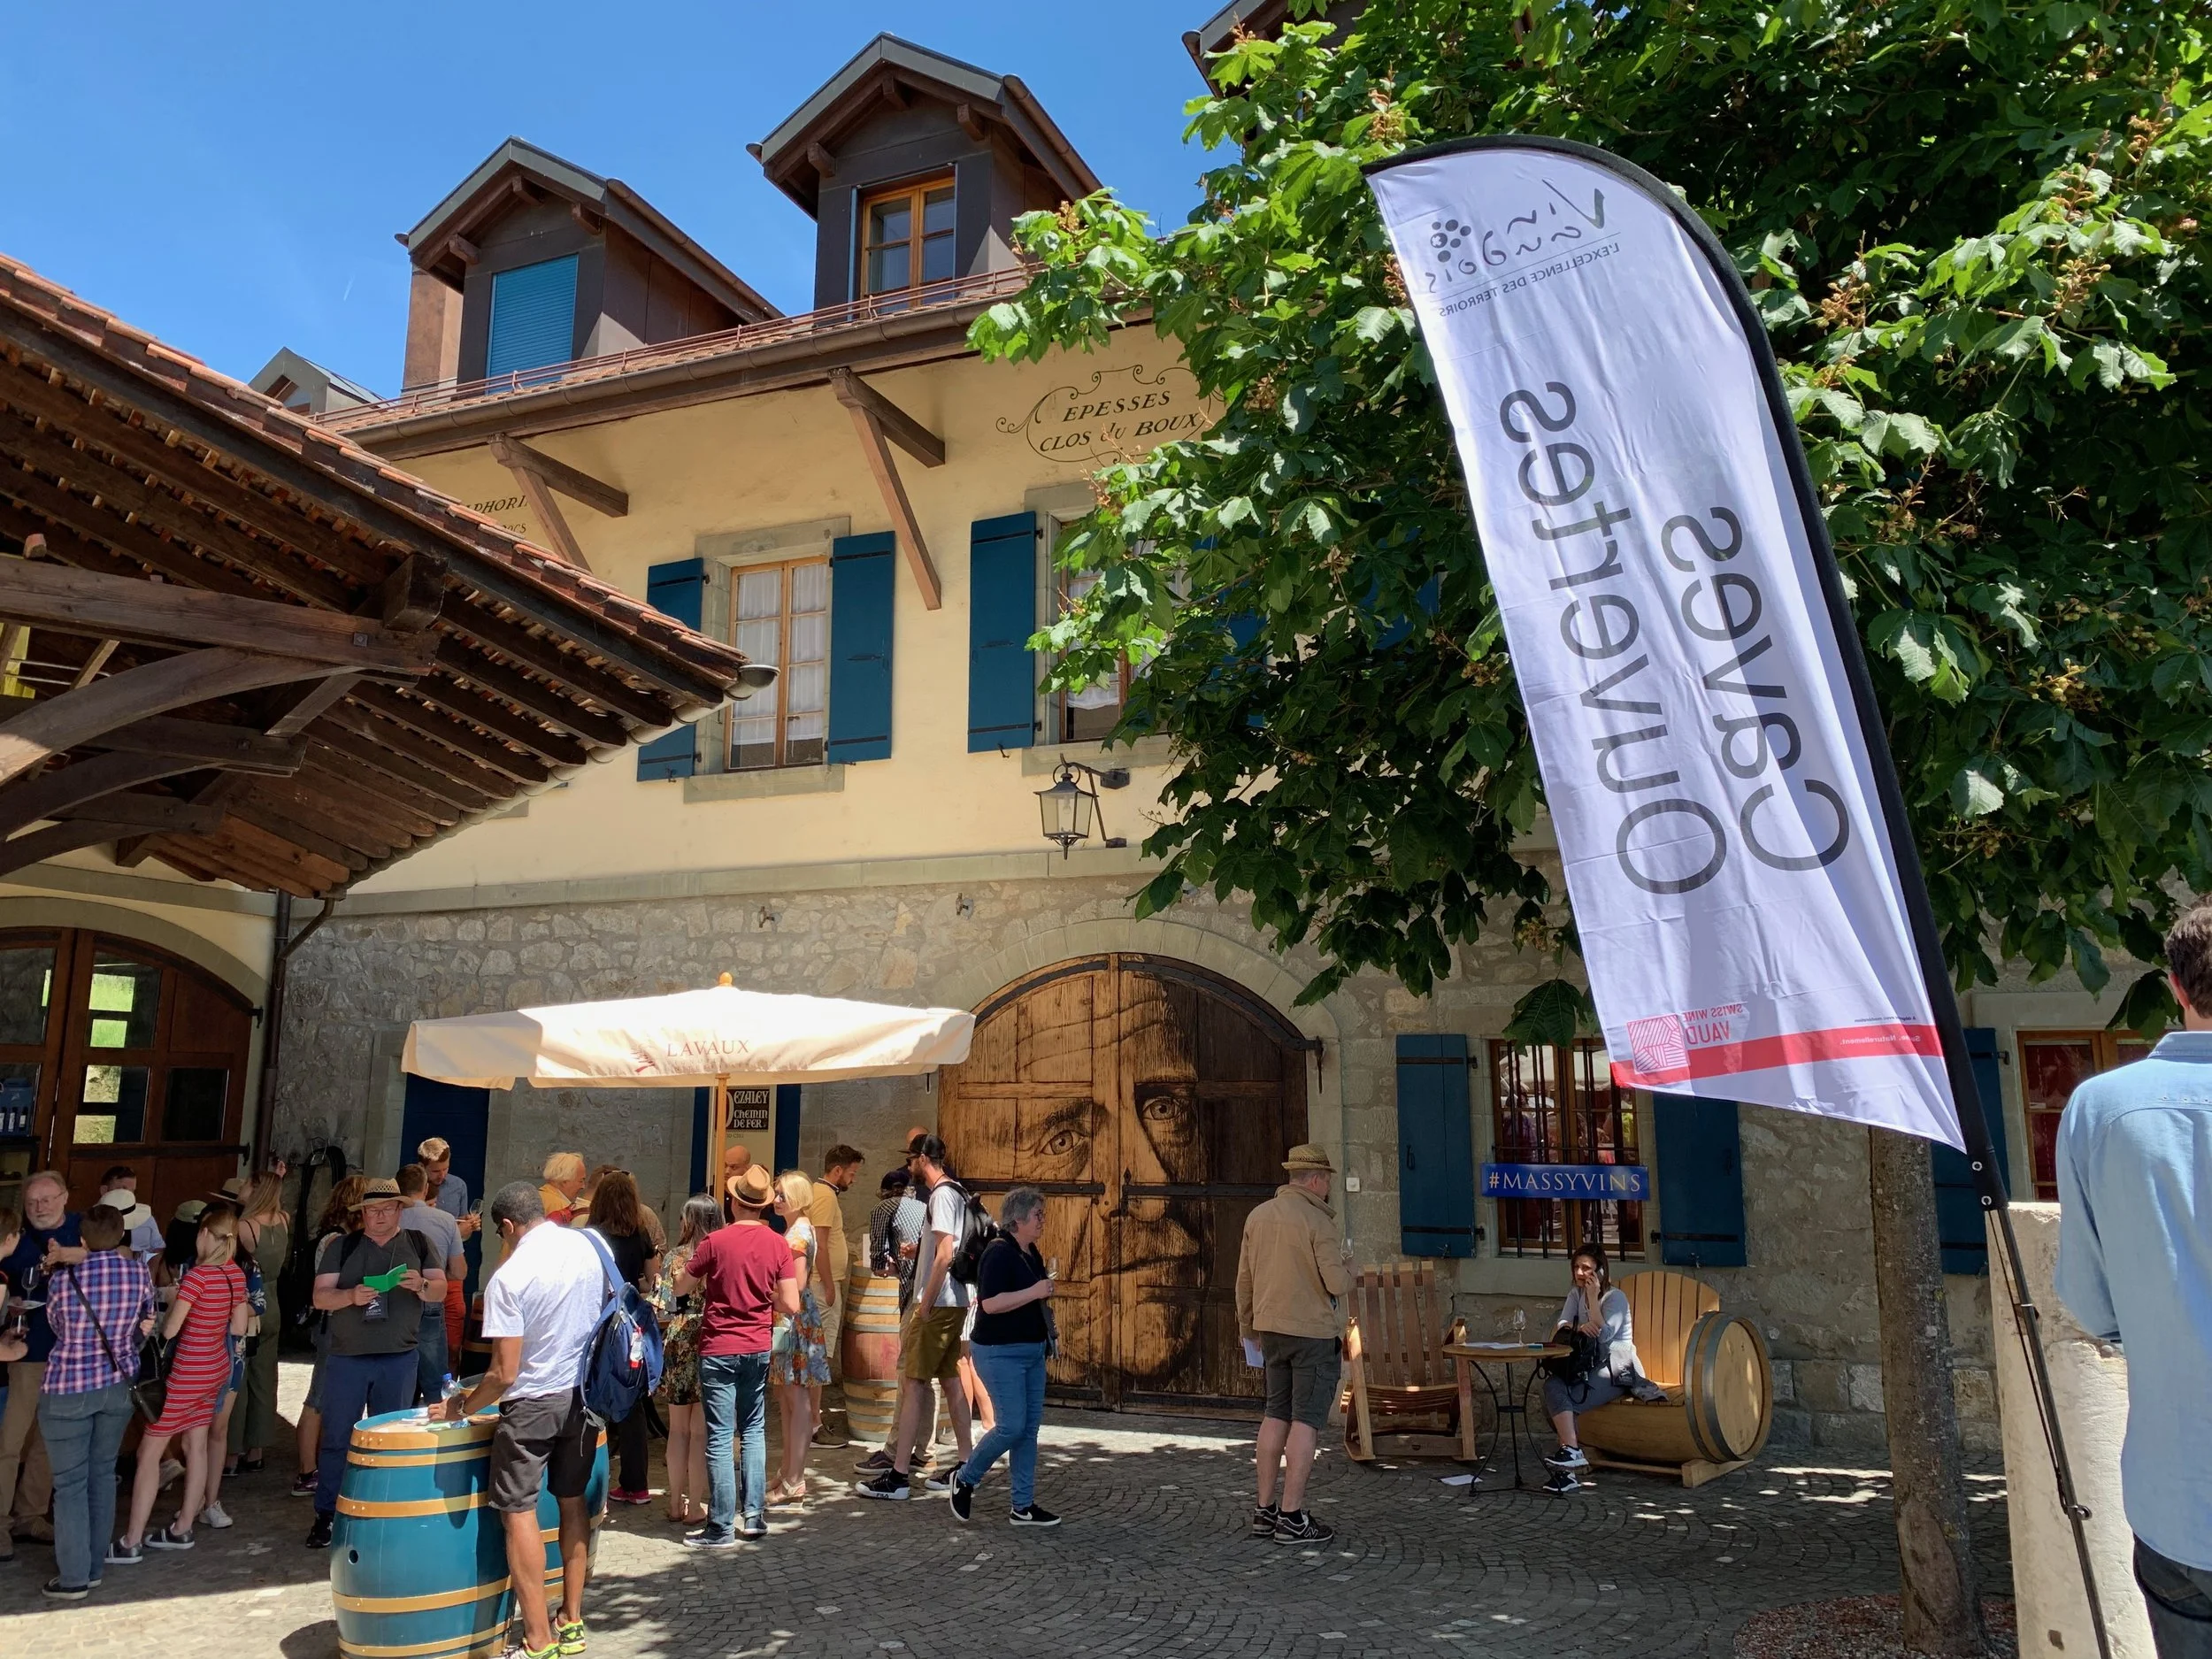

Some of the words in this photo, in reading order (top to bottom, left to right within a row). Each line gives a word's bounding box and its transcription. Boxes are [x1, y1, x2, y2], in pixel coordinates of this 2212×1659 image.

[1062, 390, 1171, 423] EPESSES
[1040, 430, 1093, 452] CLOS
[1134, 411, 1200, 438] BOUX
[667, 1040, 749, 1057] LAVAUX
[733, 1119, 745, 1128] DE
[1489, 1171, 1640, 1192] #MASSYVINS
